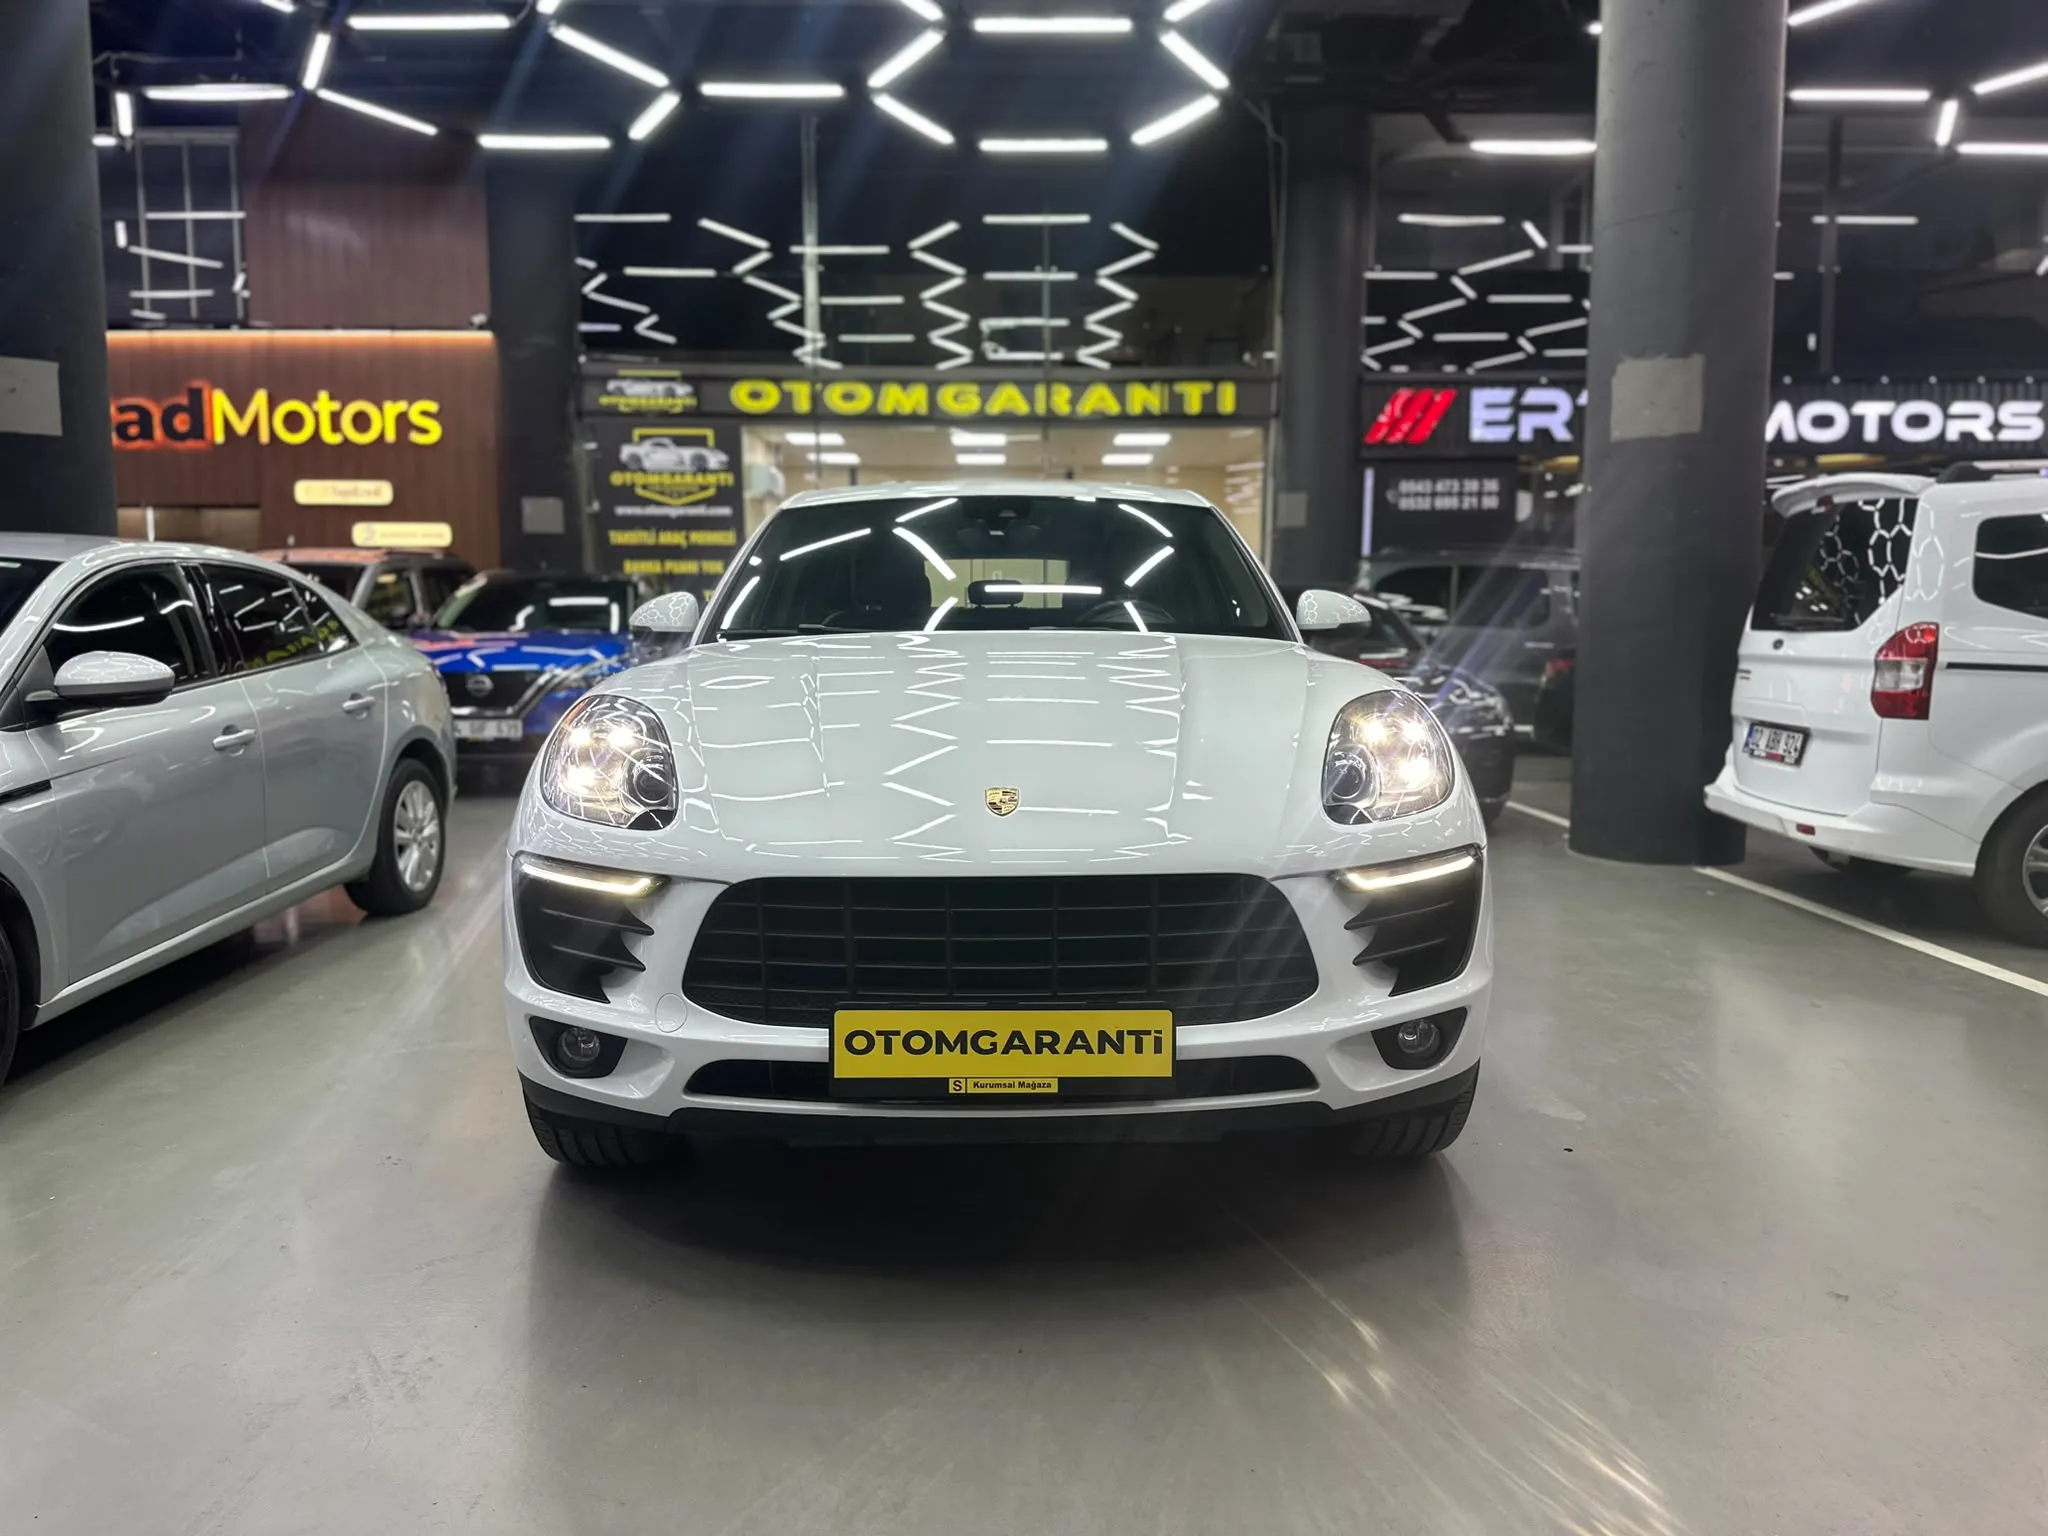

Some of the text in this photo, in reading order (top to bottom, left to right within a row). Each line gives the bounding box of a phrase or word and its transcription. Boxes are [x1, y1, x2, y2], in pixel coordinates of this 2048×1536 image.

[730, 379, 1237, 416] OTOMGARANTI
[952, 1080, 1052, 1093] S Kurumsal Mağaza
